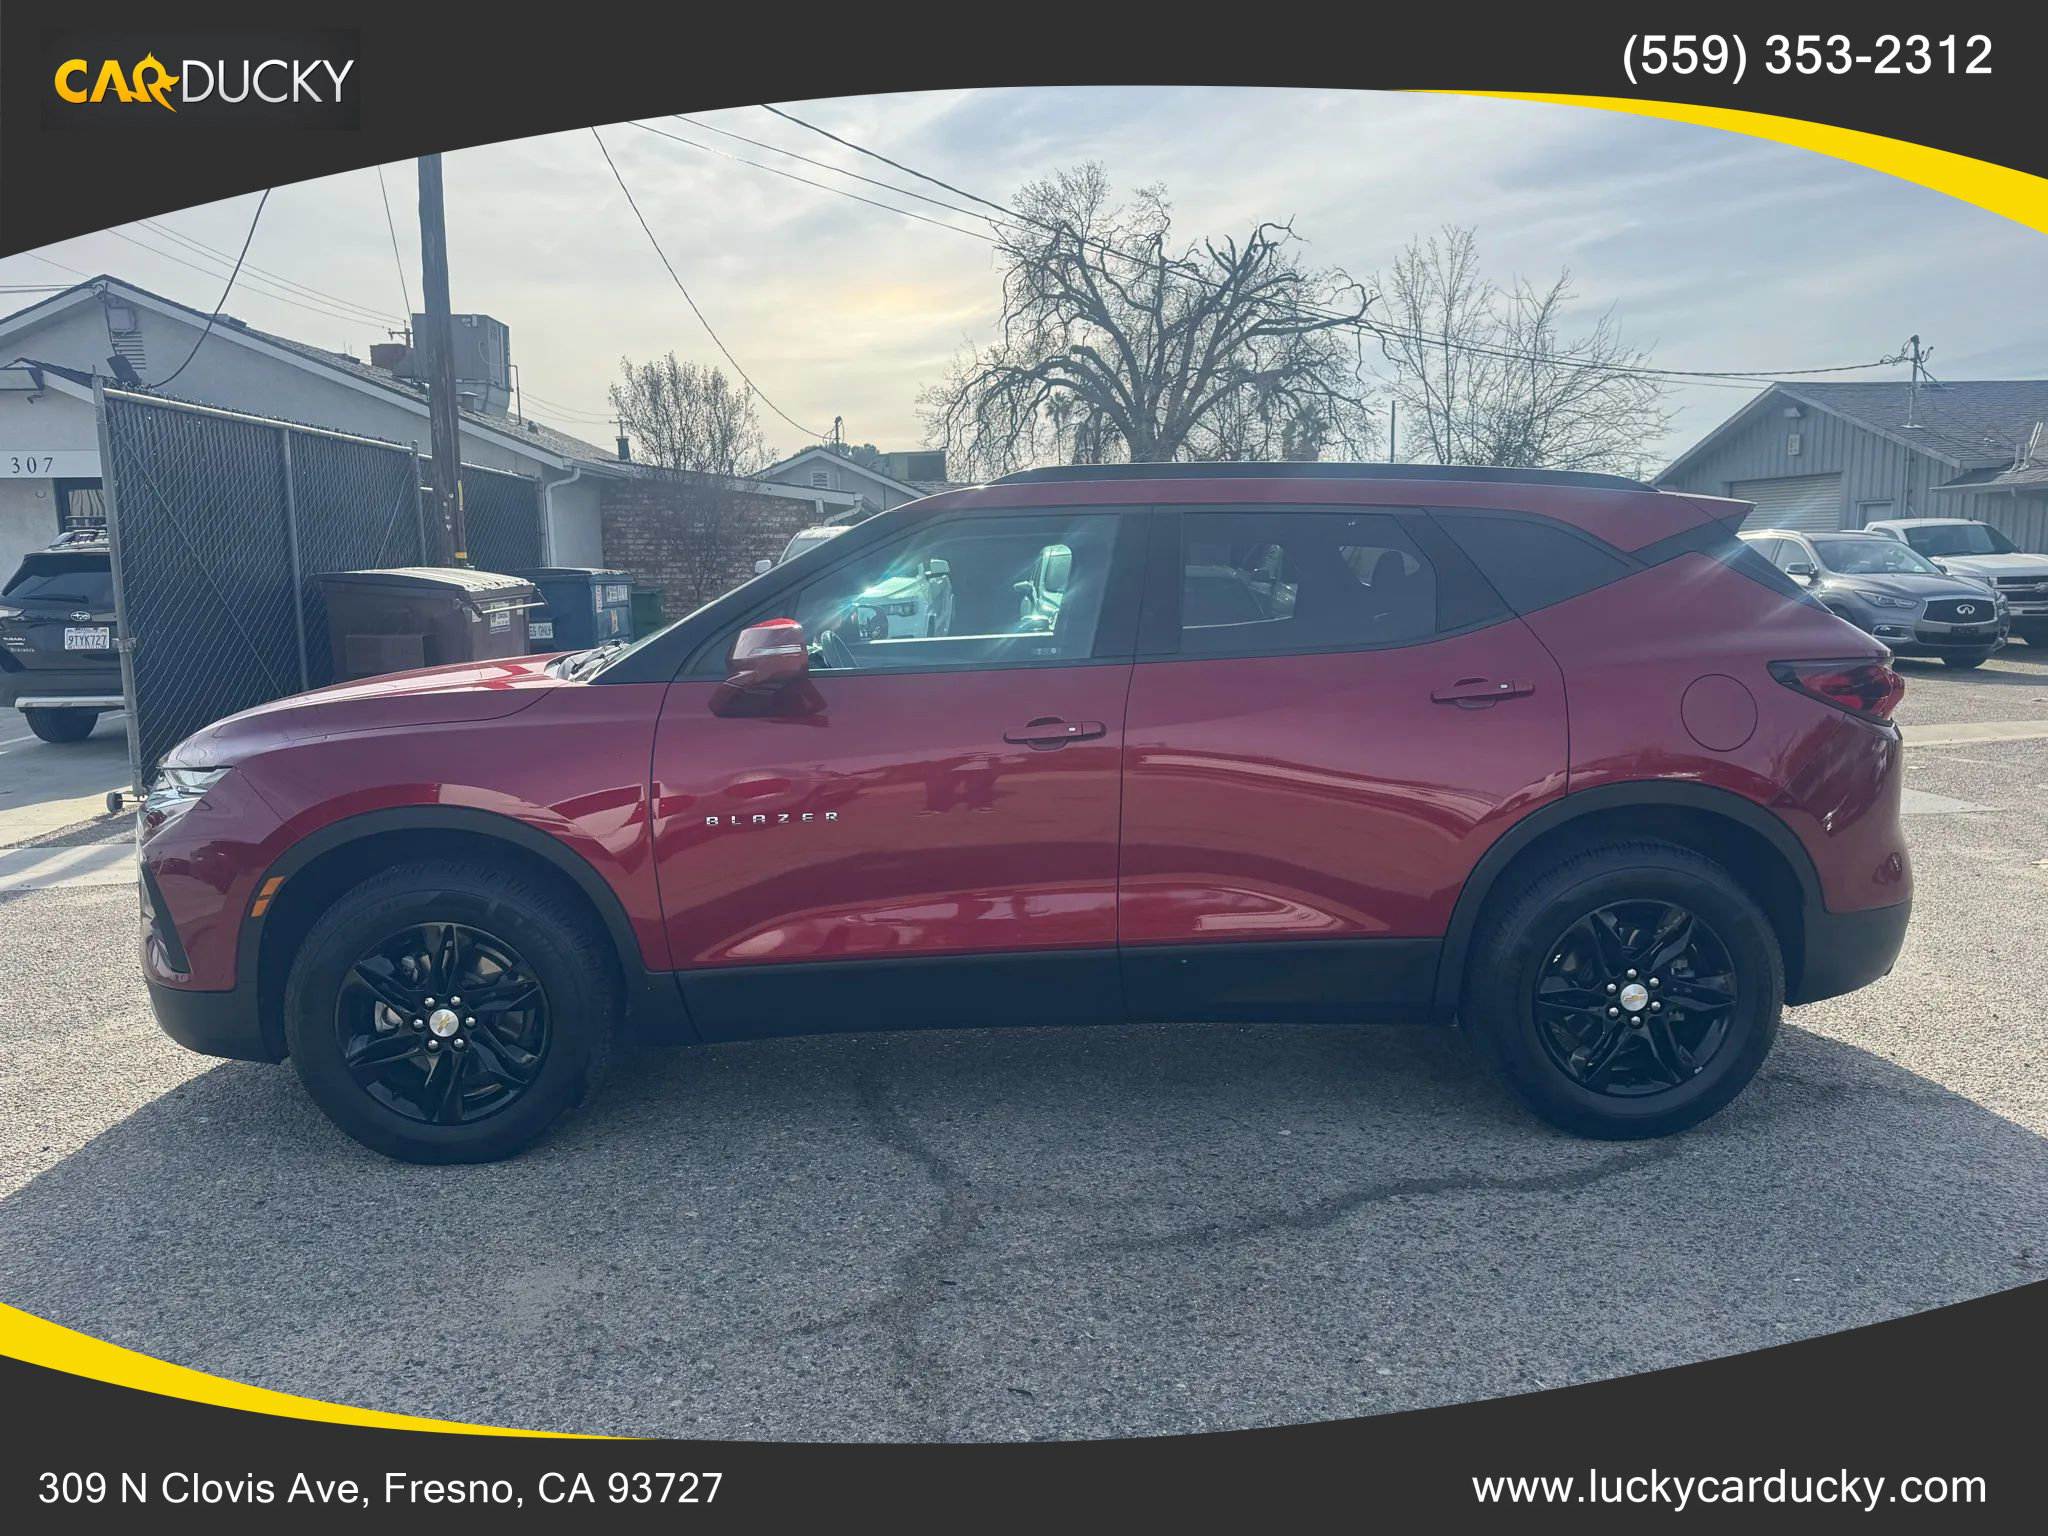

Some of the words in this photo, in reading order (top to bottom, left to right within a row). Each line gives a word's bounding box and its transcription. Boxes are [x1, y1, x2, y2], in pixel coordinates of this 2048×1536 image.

[10, 456, 54, 475] 307
[68, 634, 107, 647] 9TYK727
[705, 811, 839, 826] BLAZER
